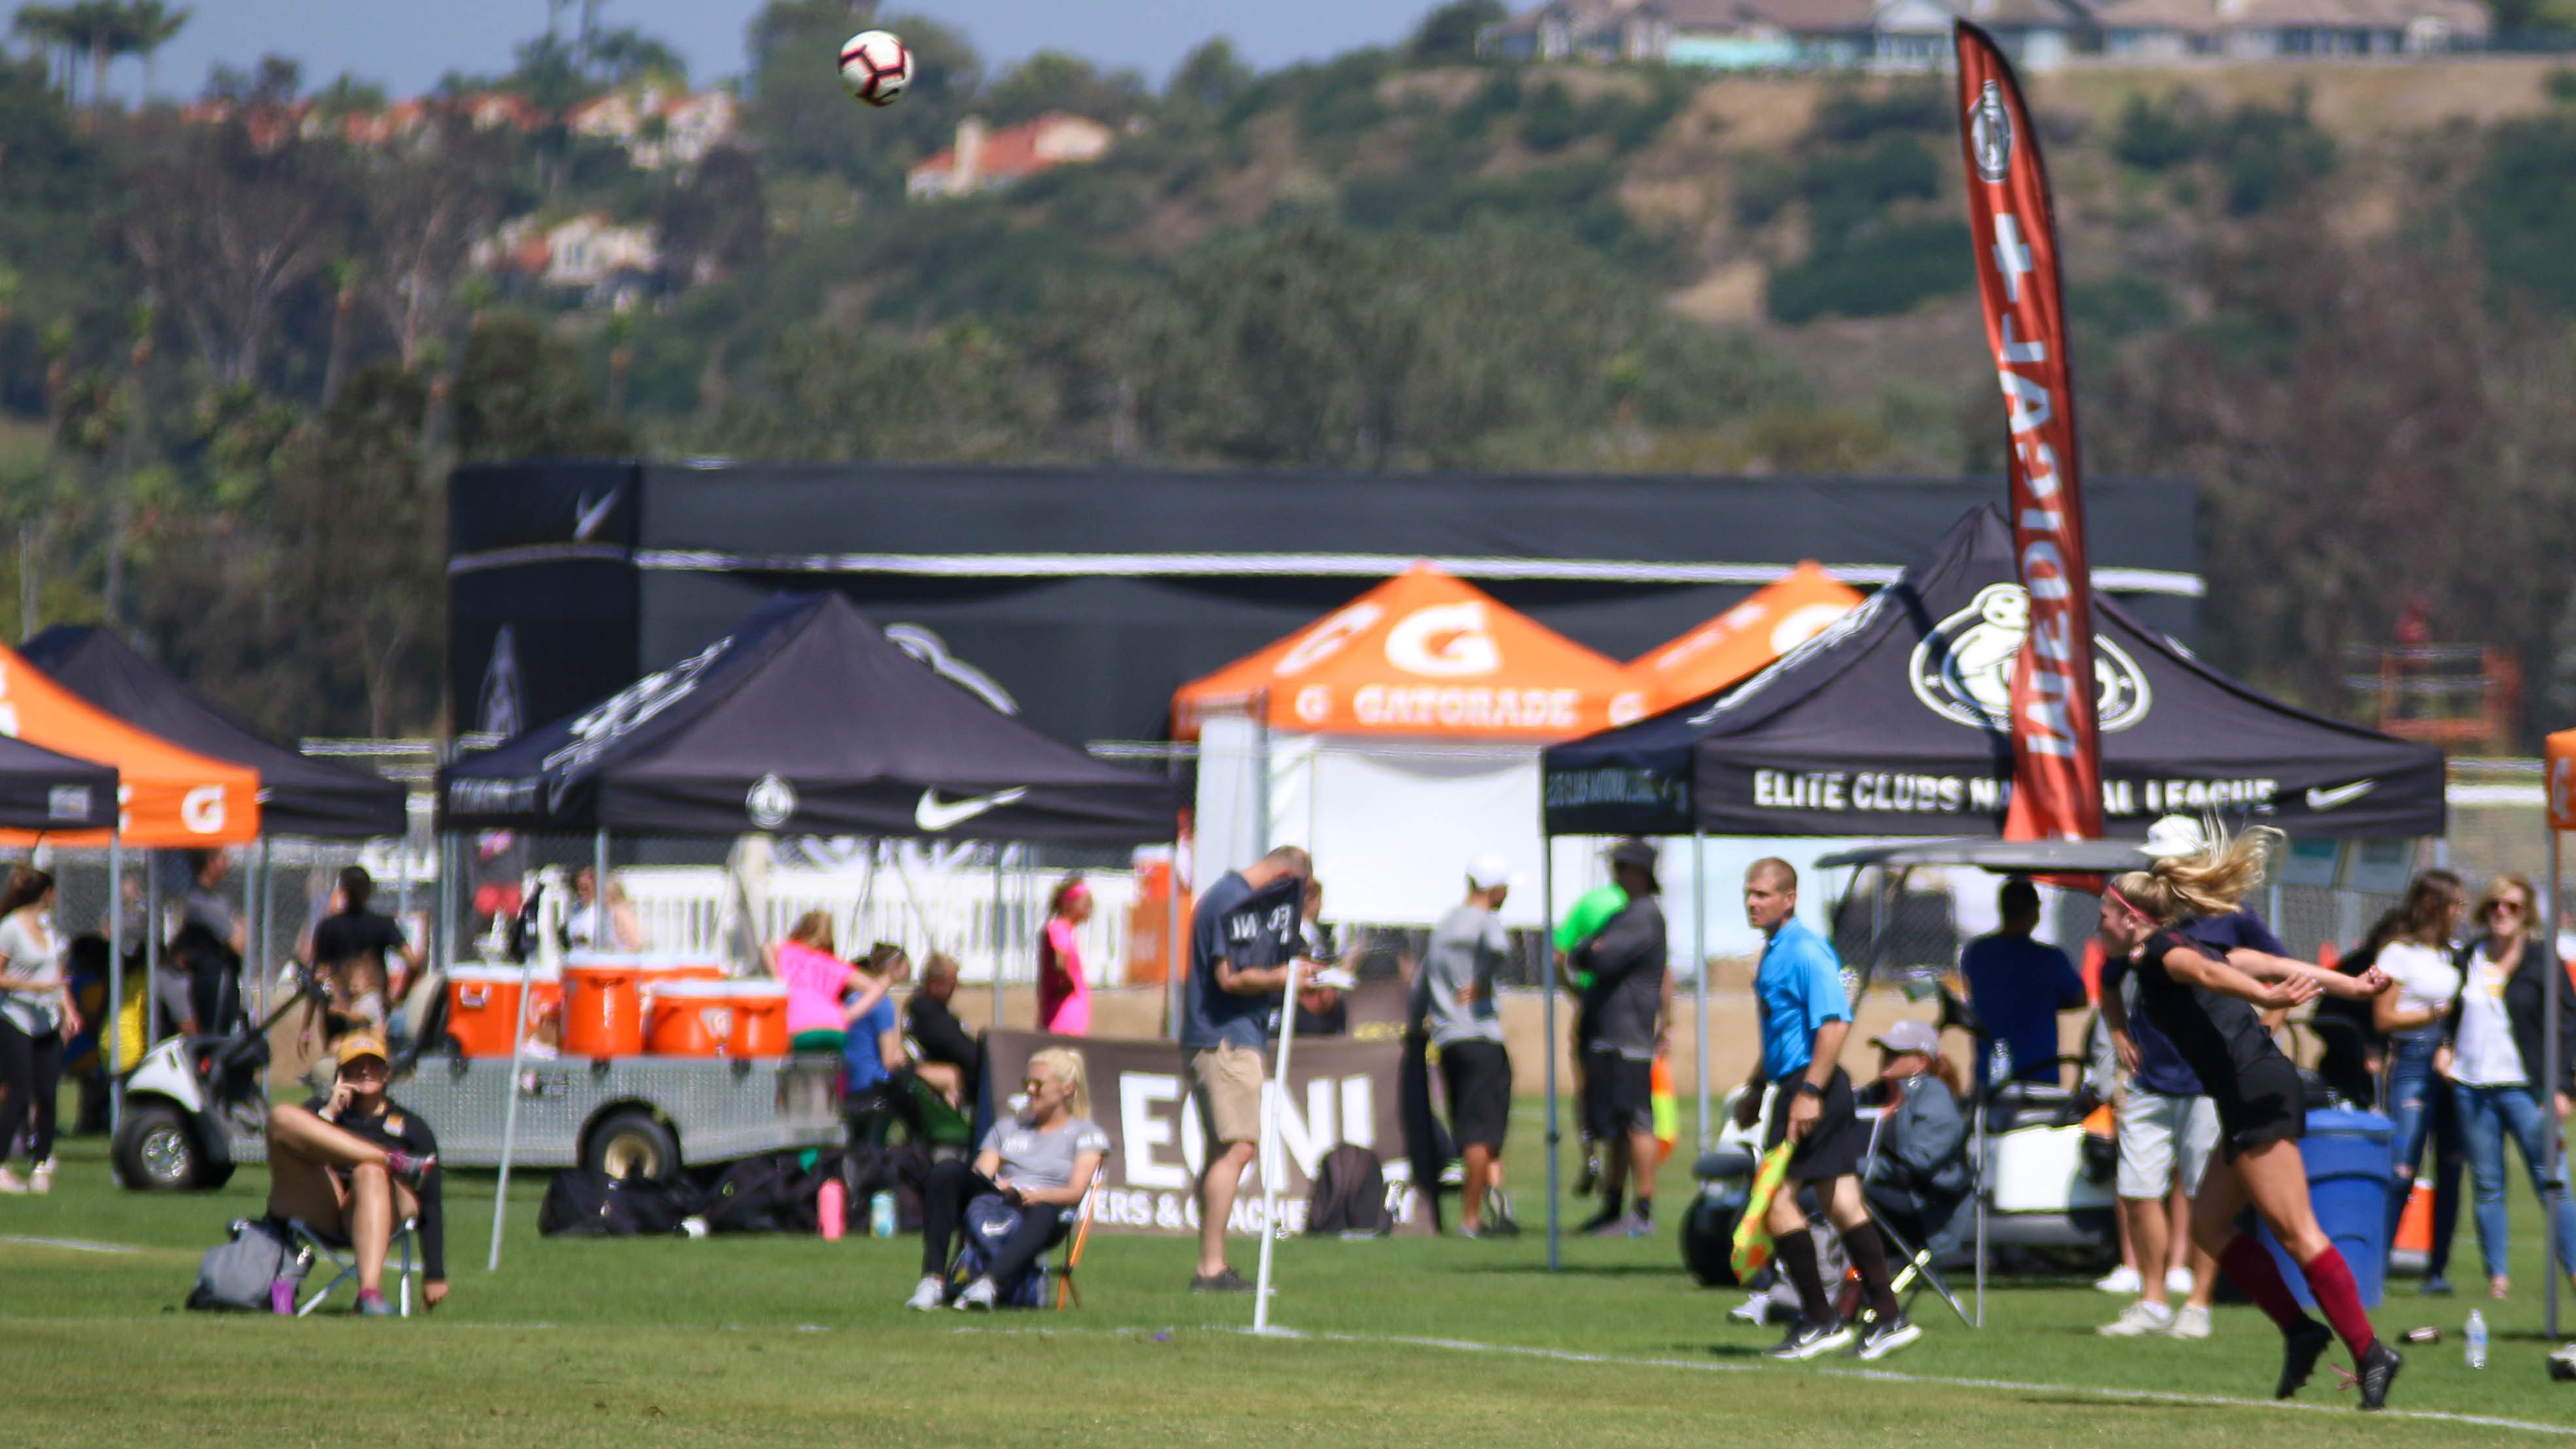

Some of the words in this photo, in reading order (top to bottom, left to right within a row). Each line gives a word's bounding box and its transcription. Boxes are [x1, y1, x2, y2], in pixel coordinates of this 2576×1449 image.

[1384, 602, 1500, 676] G
[1353, 685, 1581, 727] GATORADE
[181, 784, 227, 834] G
[1755, 768, 1846, 810] ELITE
[1852, 771, 1963, 811] CLUBS
[1155, 1191, 1182, 1227] &
